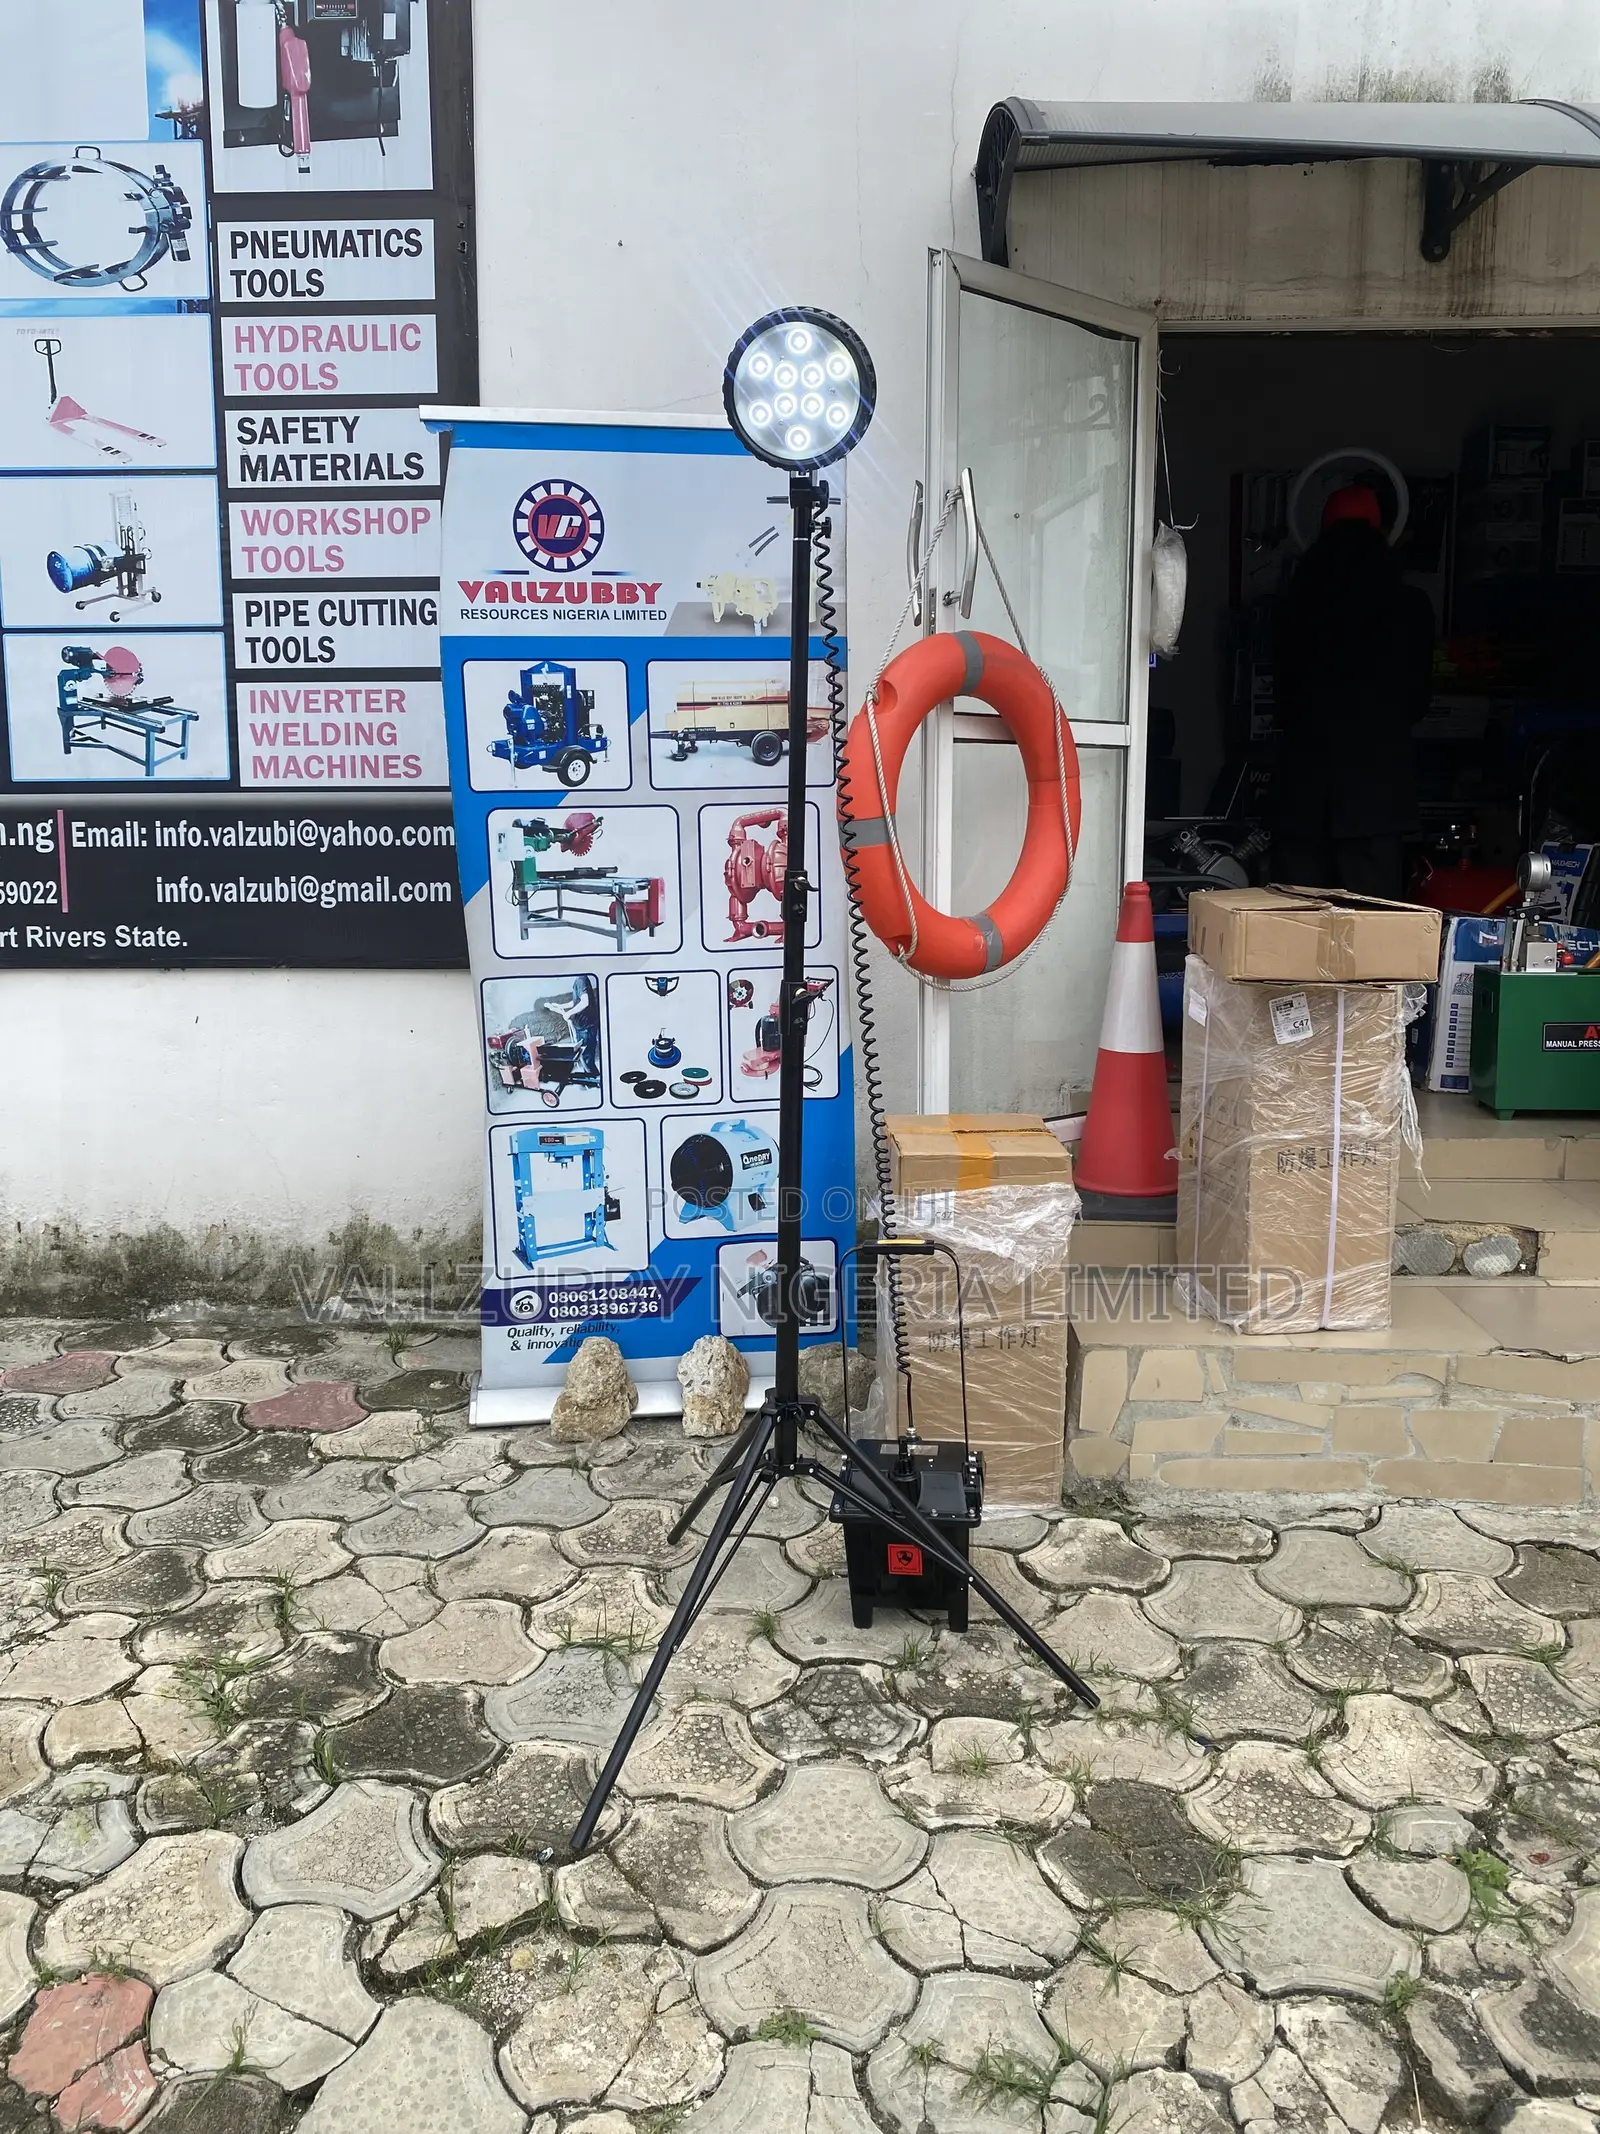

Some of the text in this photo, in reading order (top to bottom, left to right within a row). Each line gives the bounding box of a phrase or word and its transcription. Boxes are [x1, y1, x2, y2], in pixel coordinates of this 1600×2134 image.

[230, 228, 423, 259] PNEUMATICS
[230, 268, 325, 298] TOOLS
[234, 322, 422, 354] HYDRAULIC
[234, 362, 339, 391] TOOLS
[237, 415, 360, 446] SAFETY
[239, 452, 424, 482] MATERIALS
[241, 507, 431, 536] WORKSHOP
[242, 545, 345, 573] TOOLS
[457, 581, 663, 604] VALLZUBBY
[245, 598, 438, 627] PIPE CUTTING
[460, 609, 667, 621] RESOURCES NIGERIA LIMITED
[245, 636, 336, 664] TOOLS
[249, 688, 407, 714] INVERTER
[250, 722, 398, 747] WELDING
[252, 754, 423, 780] MACHINES
[71, 821, 147, 848] Email:
[155, 818, 456, 852] info.valzubi@yahoo.com
[156, 875, 452, 908] info.valzubi@gmail.com
[26, 925, 106, 947] Rivers
[114, 924, 188, 947] State.
[1293, 1018, 1309, 1029] C47
[1545, 1040, 1577, 1048] MANUAL
[548, 1286, 662, 1305] 08061208447,
[549, 1301, 659, 1319] 08033396736
[507, 1321, 621, 1339] Quality, reliability,
[510, 1340, 521, 1351] &
